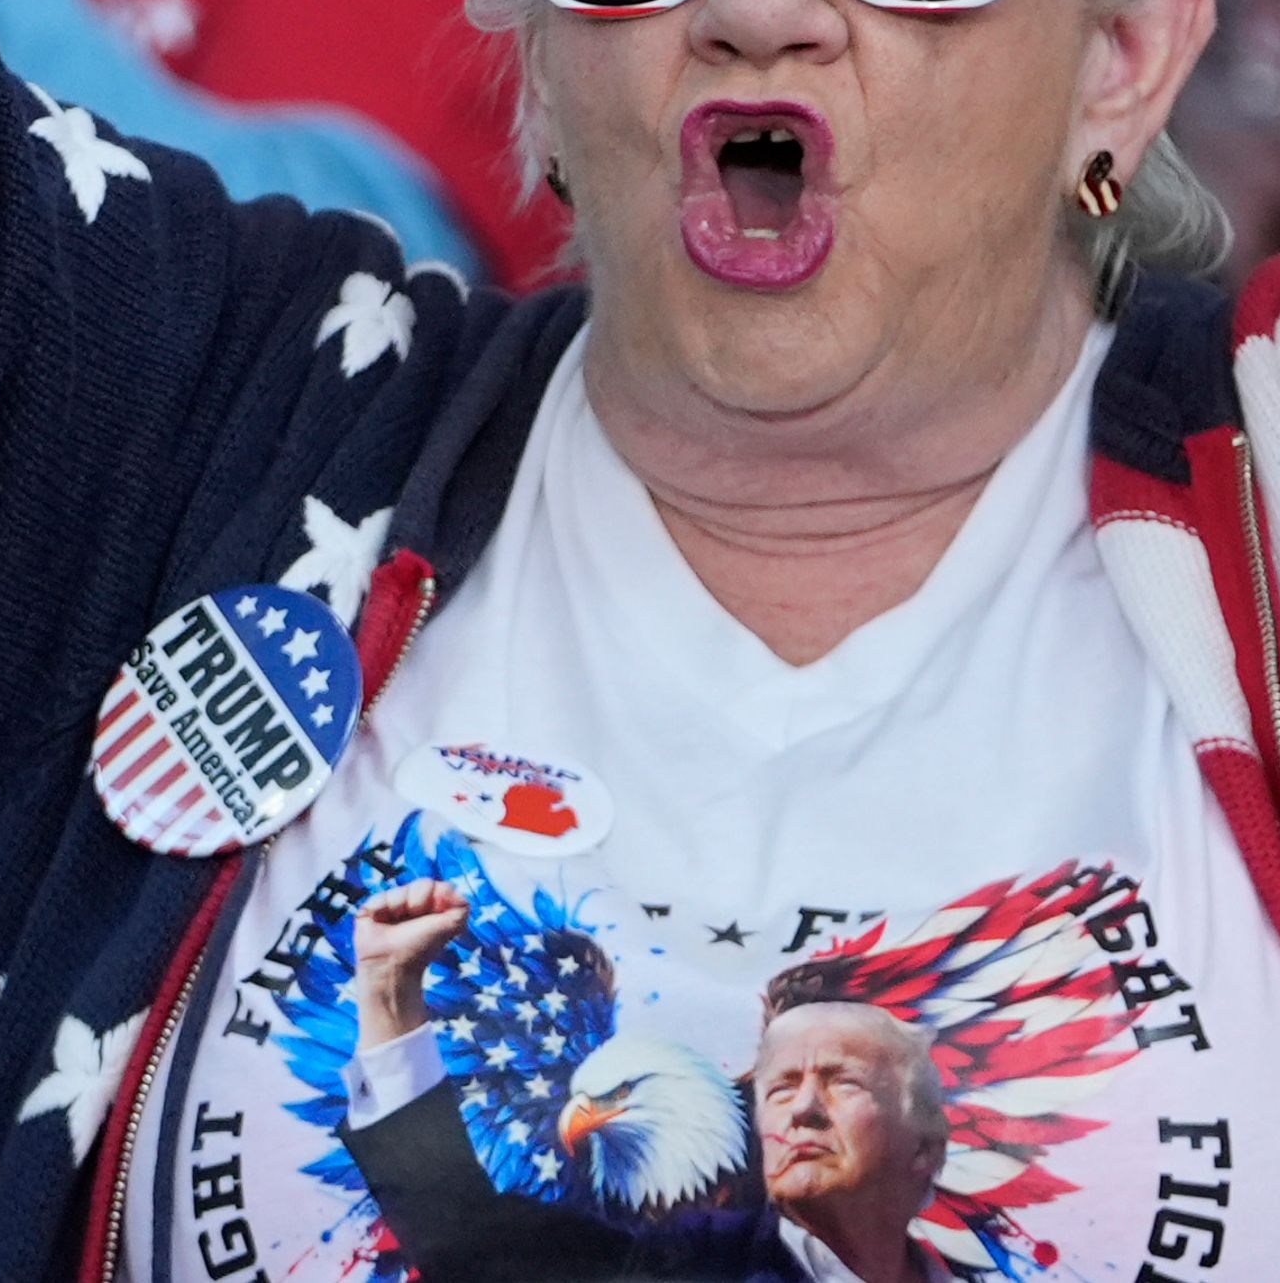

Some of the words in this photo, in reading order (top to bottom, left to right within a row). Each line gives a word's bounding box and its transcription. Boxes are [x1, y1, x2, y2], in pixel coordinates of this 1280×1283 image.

[127, 639, 178, 713] Save
[170, 705, 270, 836] America!
[162, 602, 313, 792] TRUMP
[222, 840, 409, 1047] FIGHT
[191, 1101, 272, 1283] GHT
[1134, 1116, 1233, 1283] FIG
